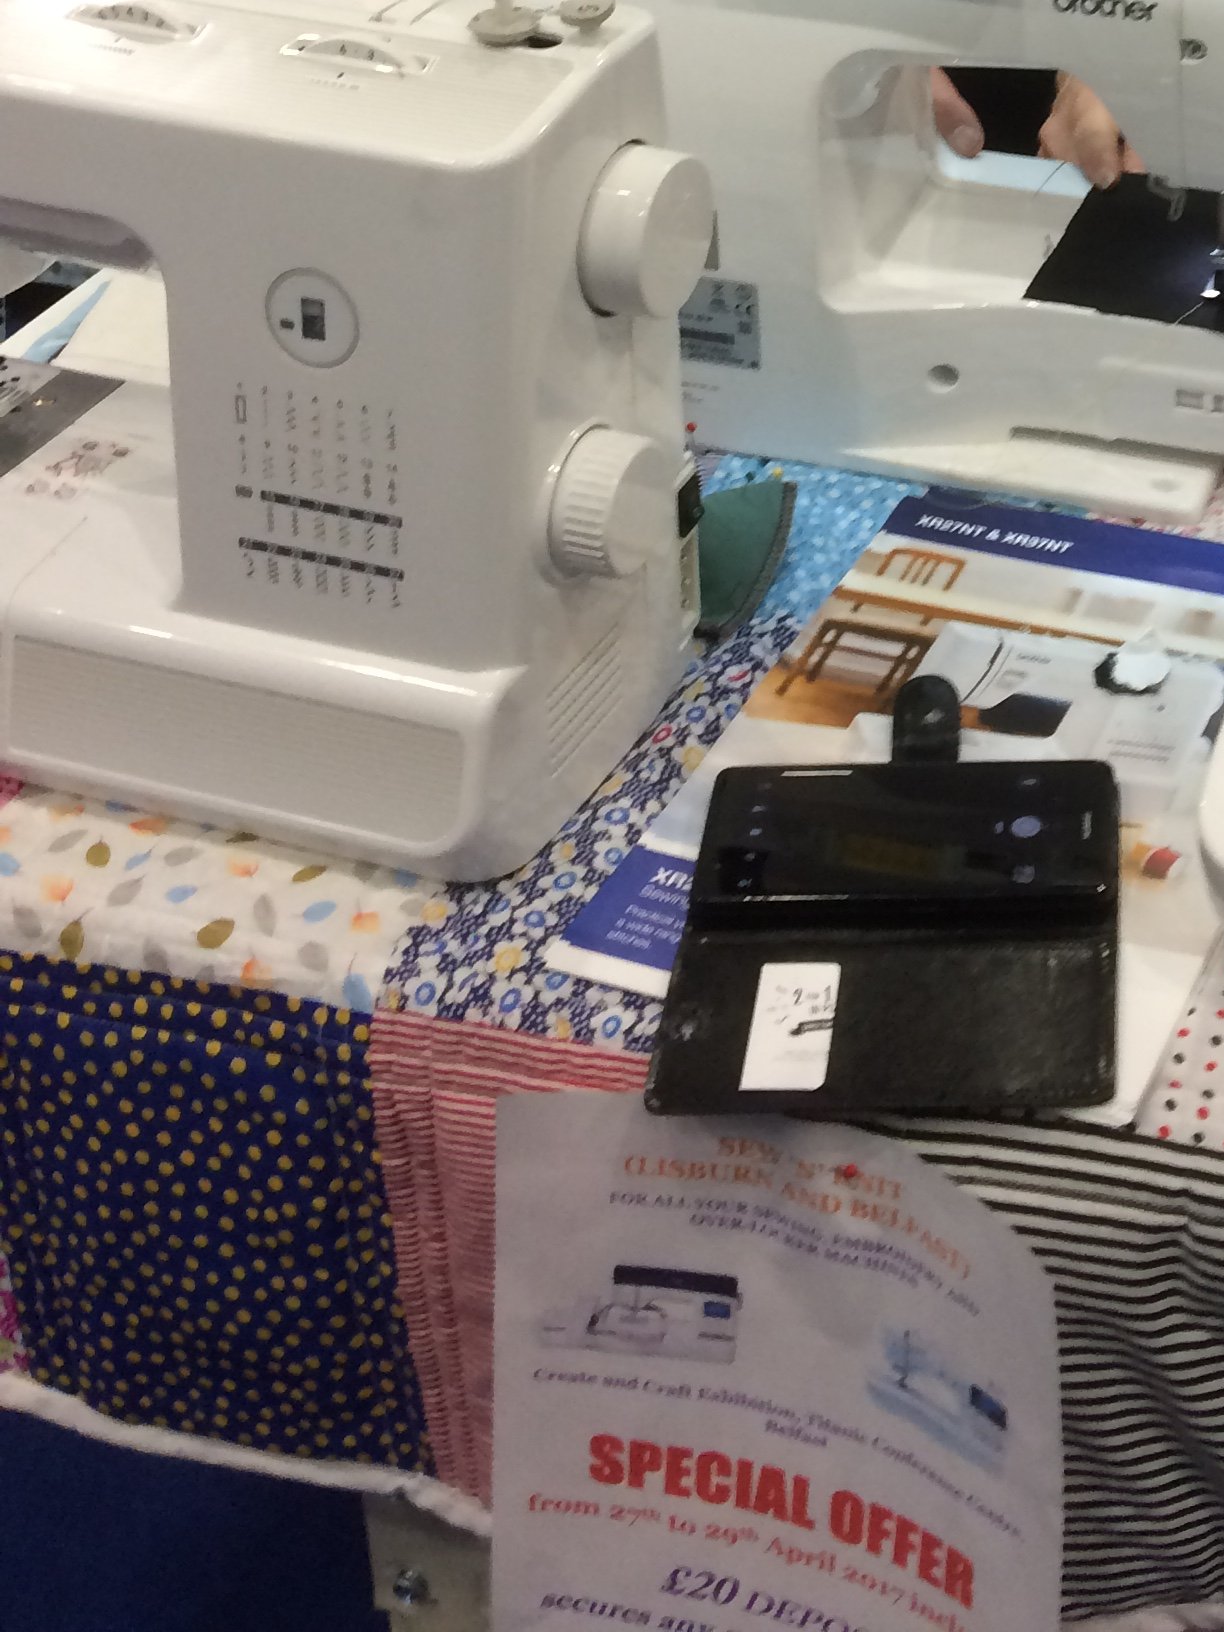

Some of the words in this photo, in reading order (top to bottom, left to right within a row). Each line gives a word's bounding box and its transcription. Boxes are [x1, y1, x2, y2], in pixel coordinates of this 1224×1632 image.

[602, 1374, 639, 1390] and
[528, 1492, 600, 1515] from
[667, 1514, 697, 1537] to
[764, 1536, 837, 1575] April
[588, 1432, 816, 1531] SPECIAL
[829, 1489, 975, 1611] OFFER
[540, 1592, 652, 1625] secures
[659, 1566, 741, 1606] £20
[744, 1590, 866, 1632] DEPO
